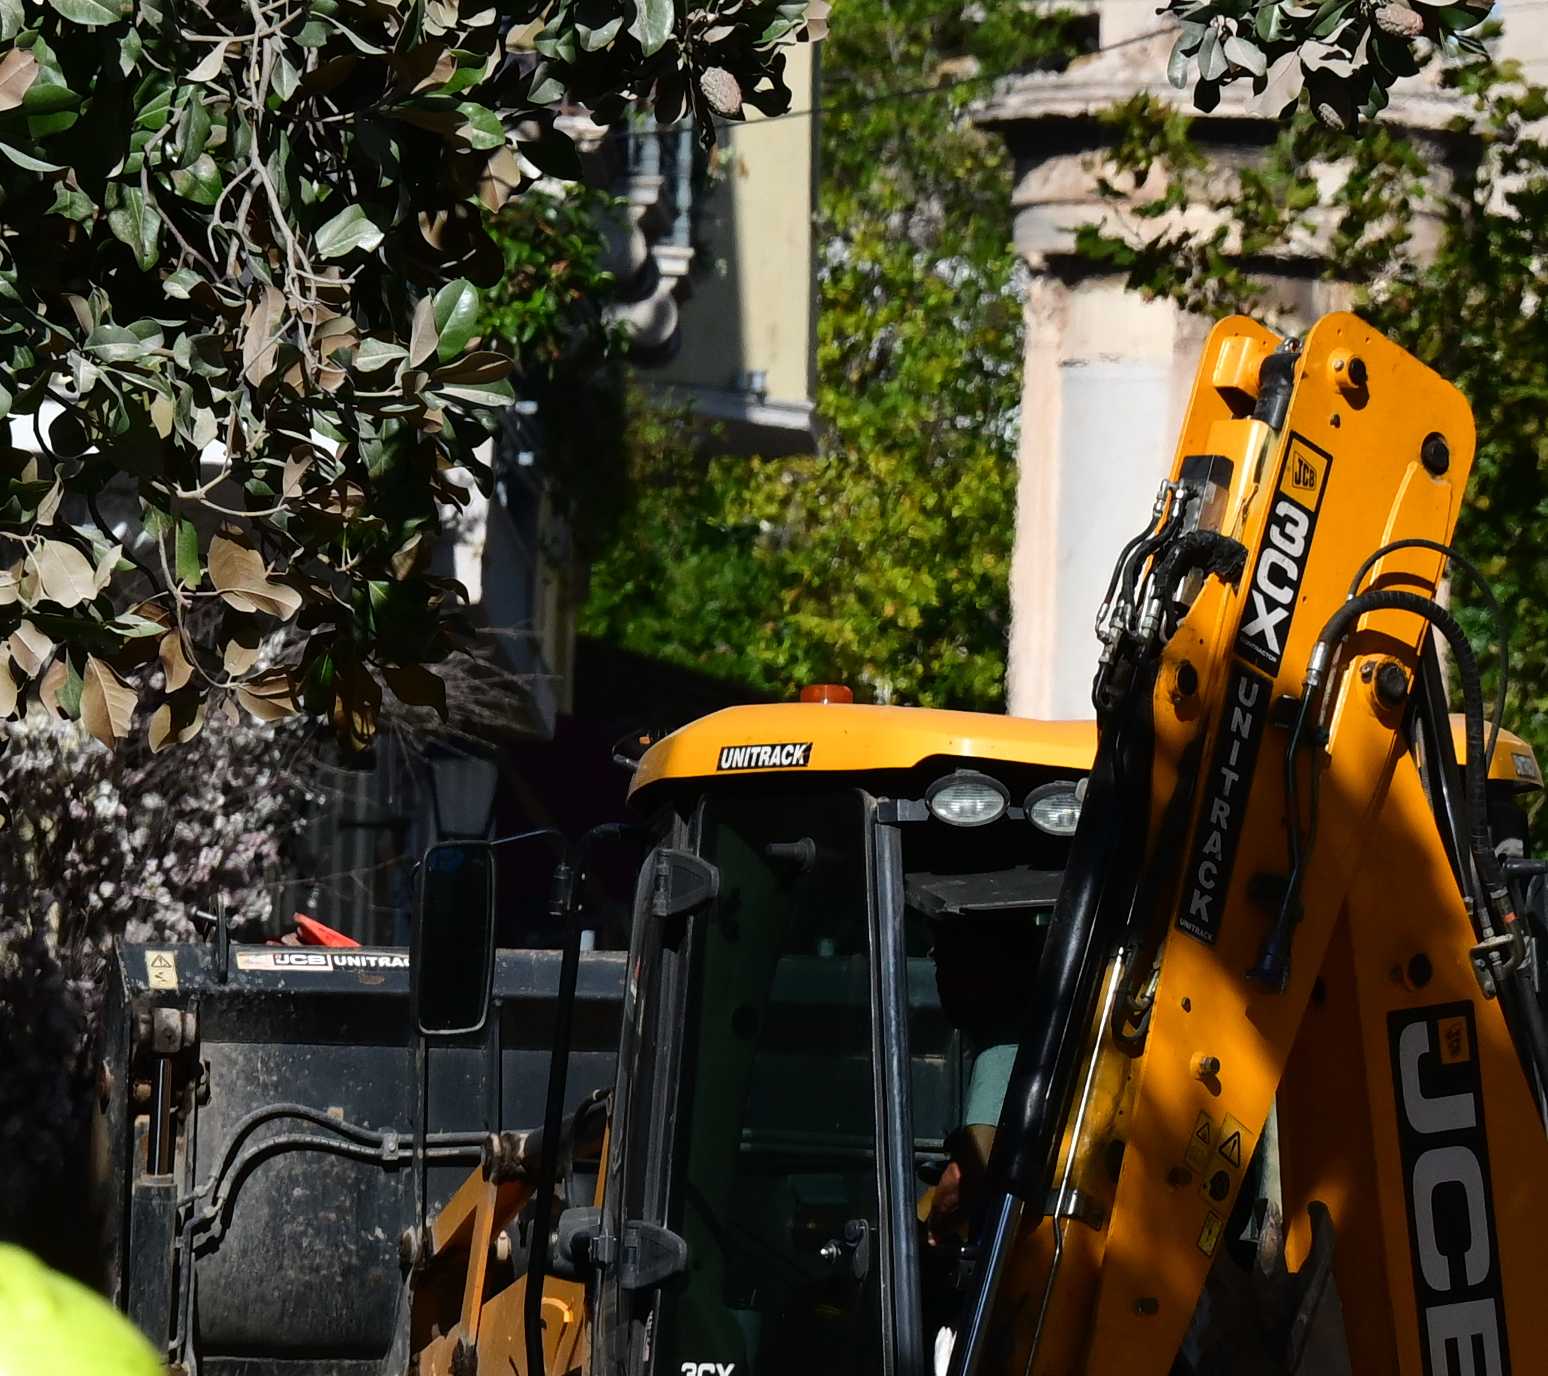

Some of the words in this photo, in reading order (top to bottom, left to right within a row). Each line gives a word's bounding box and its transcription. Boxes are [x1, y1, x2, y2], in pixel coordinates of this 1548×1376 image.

[1294, 456, 1316, 488] JCB
[1241, 500, 1310, 655] 3CX
[1240, 636, 1278, 663] CONTRACTOR
[721, 744, 810, 769] UNITRACK
[1189, 676, 1259, 923] UNITRACK
[1179, 917, 1214, 942] UNITRACK
[275, 954, 327, 965] JCB
[333, 955, 409, 967] UNITRA
